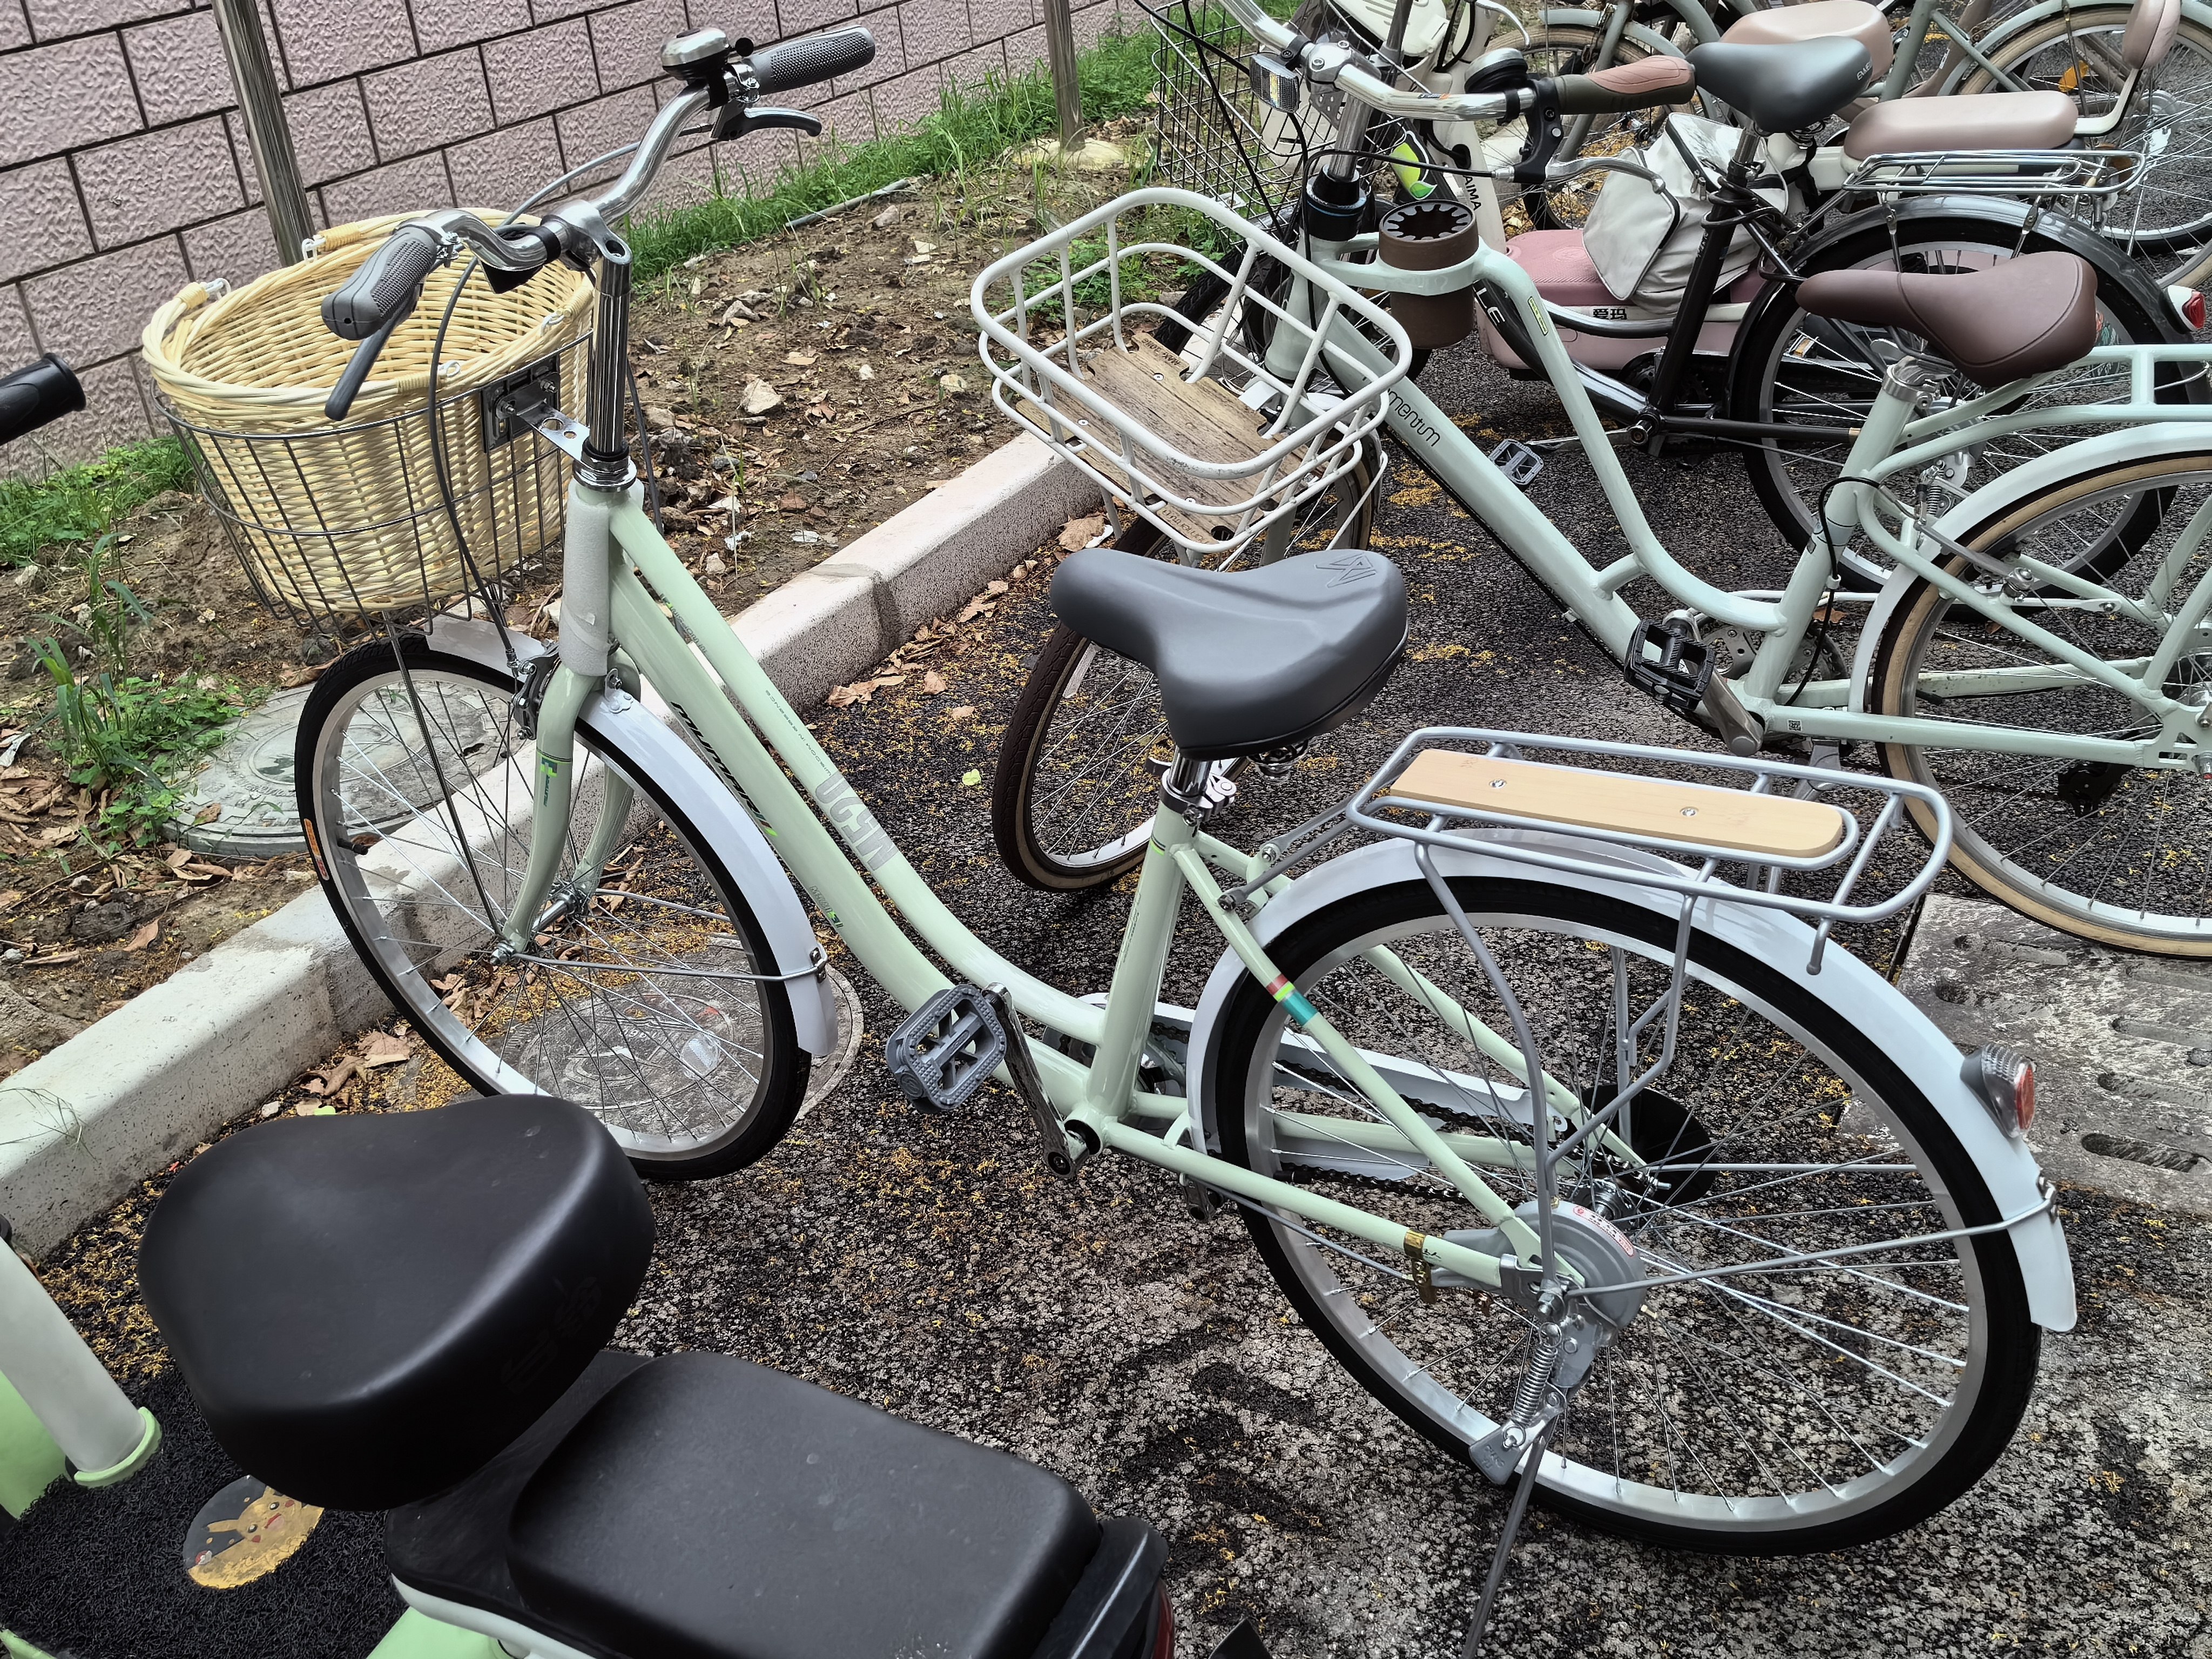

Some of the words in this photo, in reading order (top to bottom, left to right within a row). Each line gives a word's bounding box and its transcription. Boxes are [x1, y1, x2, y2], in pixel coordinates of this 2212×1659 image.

[1462, 175, 1481, 211] AIMA
[1472, 286, 1506, 326] LE
[1593, 308, 1627, 320] 爱玛
[1386, 388, 1441, 447] mentum
[815, 771, 899, 872] M520
